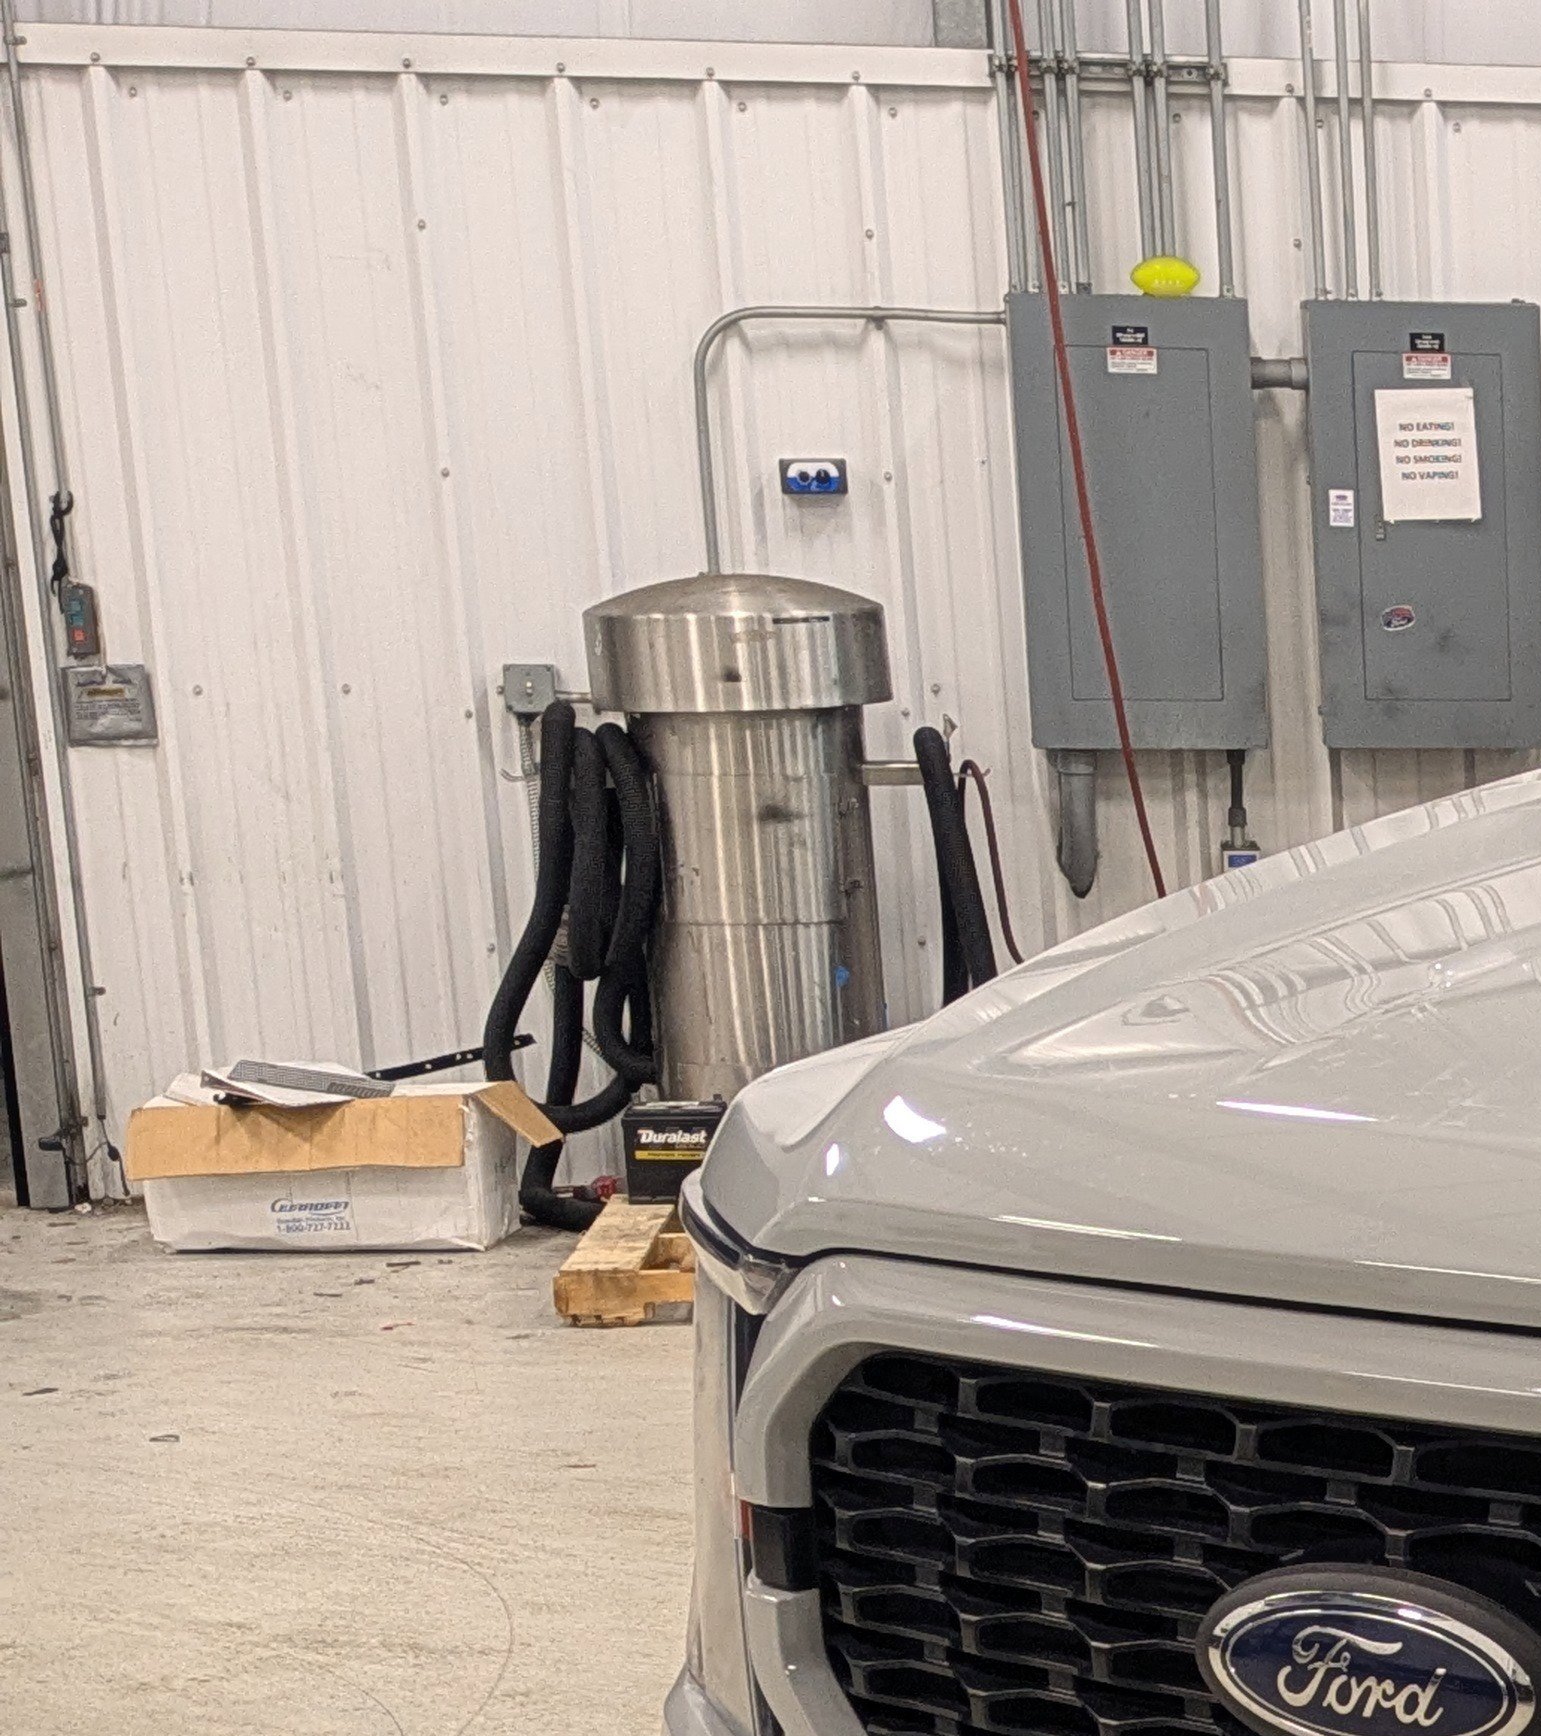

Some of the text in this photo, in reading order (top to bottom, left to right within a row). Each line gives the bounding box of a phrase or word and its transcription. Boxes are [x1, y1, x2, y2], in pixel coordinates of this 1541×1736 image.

[1399, 422, 1454, 431] NO EATING!
[1394, 439, 1461, 448] NO DRINKING!
[1396, 455, 1461, 464] NO SMOKING!
[1402, 471, 1459, 480] NO VAPING!
[637, 1129, 707, 1143] Duralast
[1277, 1625, 1447, 1727] Ford
